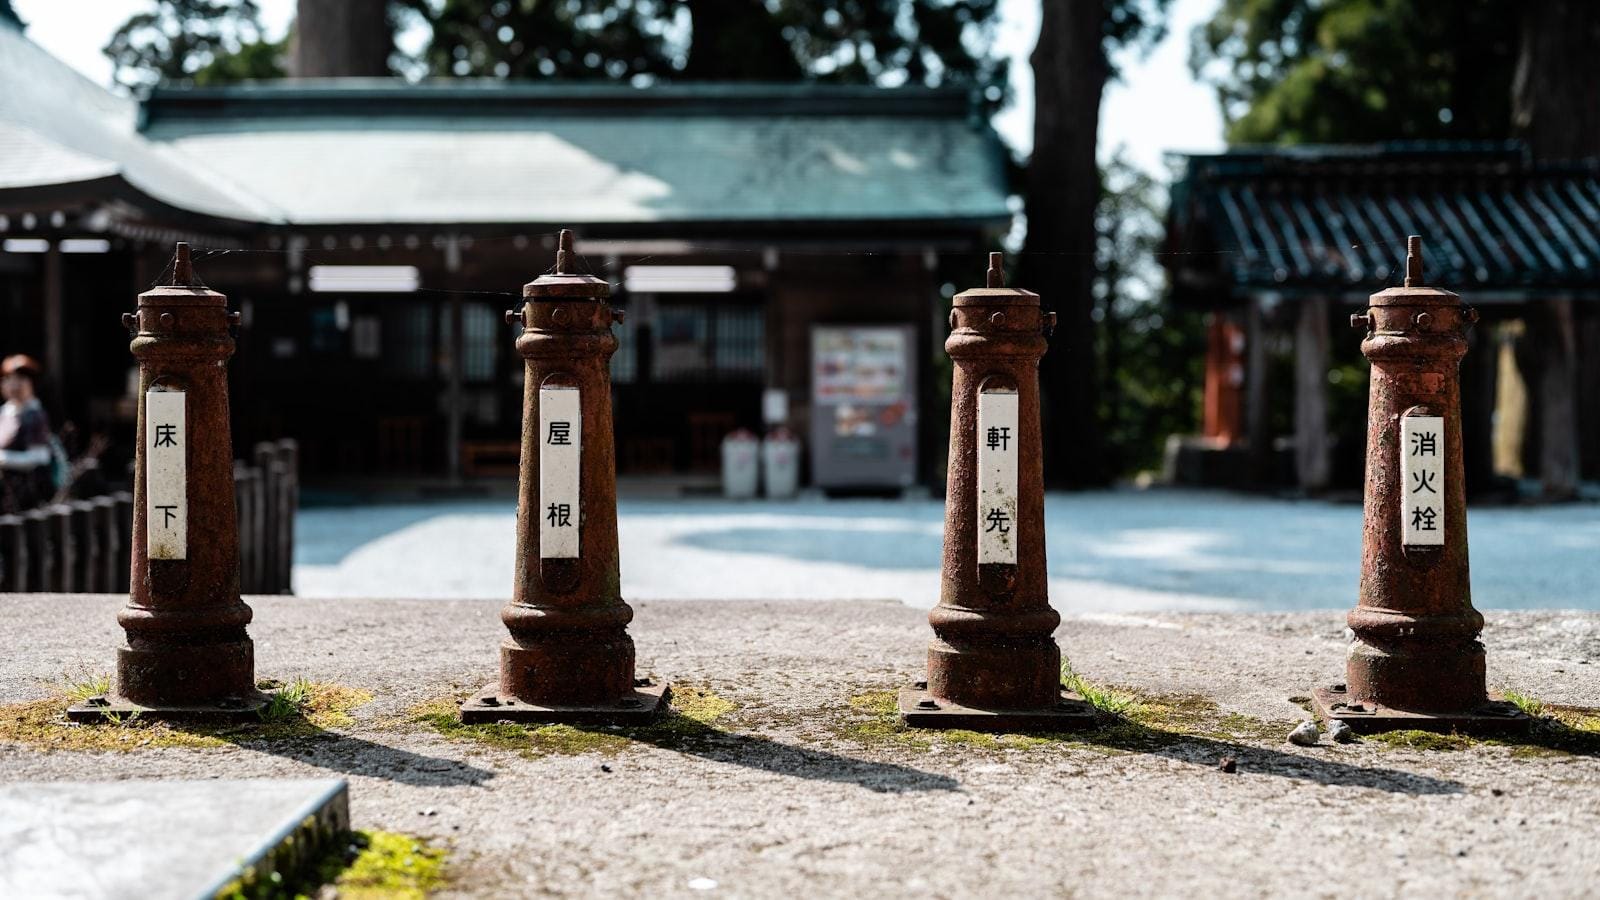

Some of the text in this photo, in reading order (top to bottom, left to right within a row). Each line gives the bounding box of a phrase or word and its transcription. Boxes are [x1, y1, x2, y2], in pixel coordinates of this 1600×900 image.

[154, 423, 178, 529] 床下
[547, 421, 572, 528] 屋根
[986, 426, 1011, 533] 軒先
[1411, 431, 1437, 531] 消火栓
